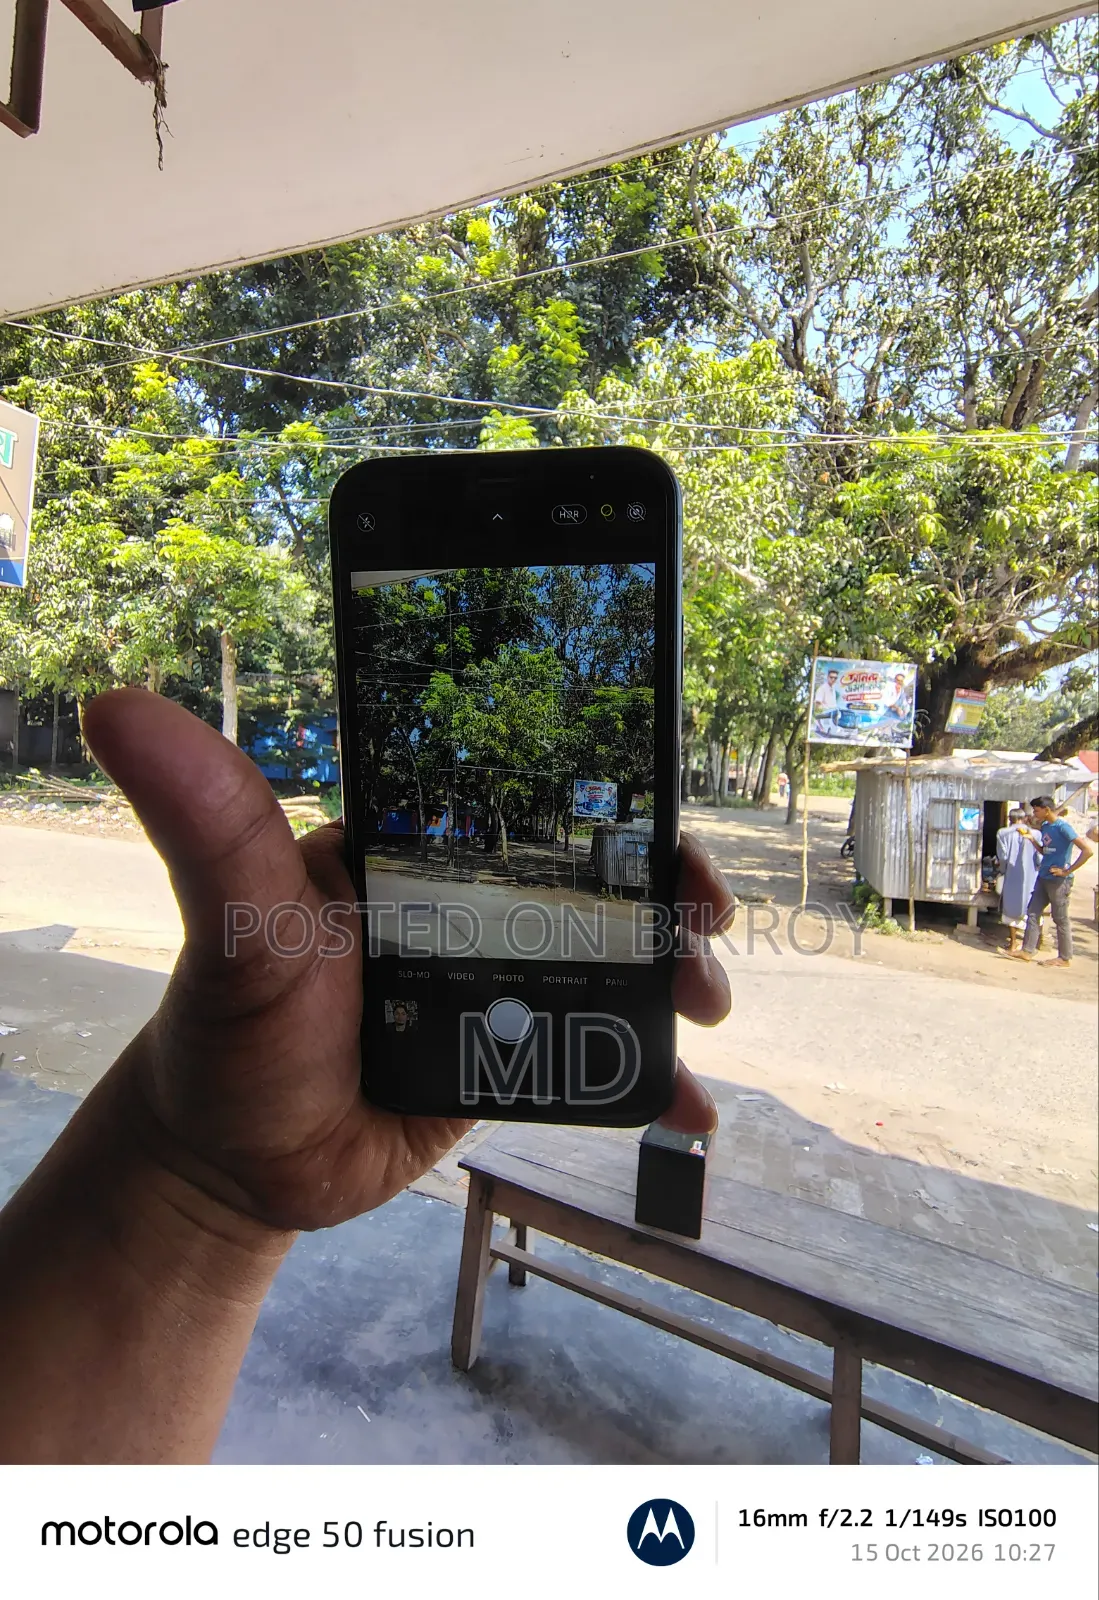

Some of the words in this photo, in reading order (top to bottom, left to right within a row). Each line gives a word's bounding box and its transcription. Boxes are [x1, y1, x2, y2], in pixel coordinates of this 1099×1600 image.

[398, 970, 430, 979] SLO-MO
[447, 972, 475, 981] VIDEO
[492, 974, 525, 983] PHOTO
[542, 975, 588, 985] PORTRAIT
